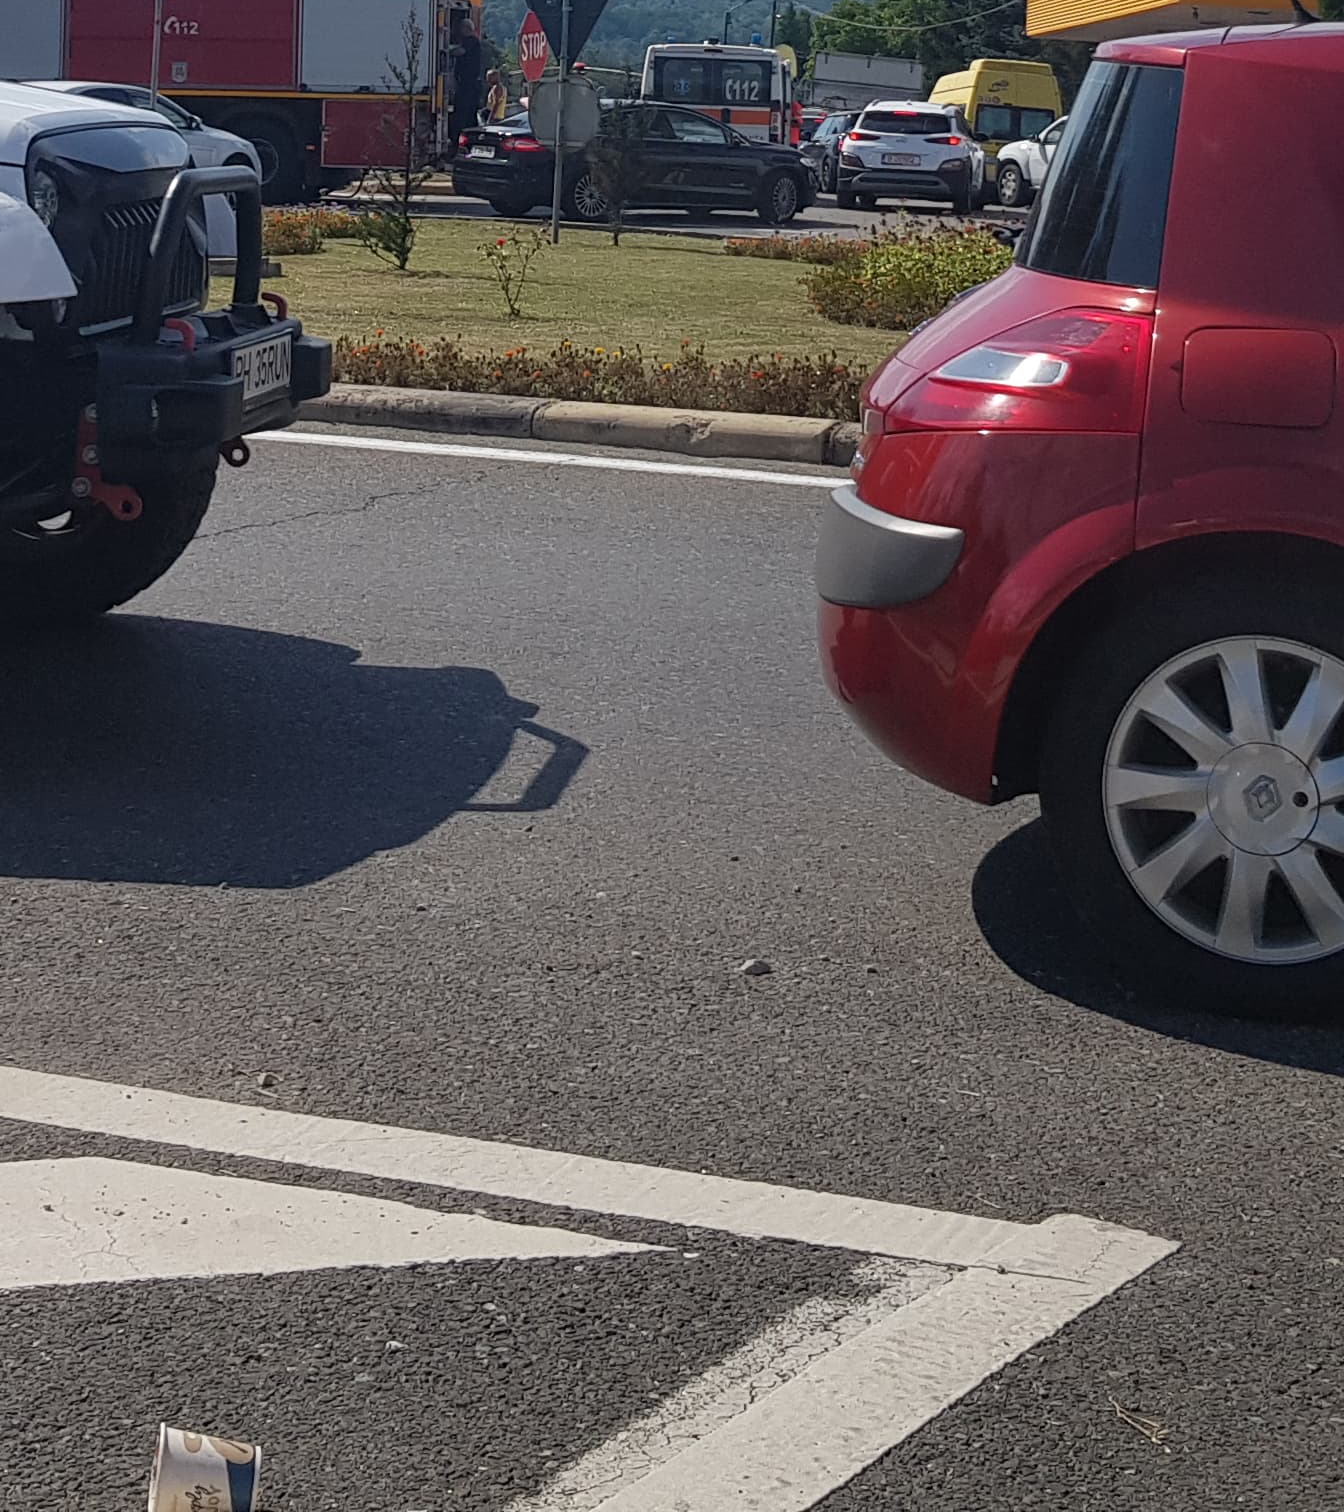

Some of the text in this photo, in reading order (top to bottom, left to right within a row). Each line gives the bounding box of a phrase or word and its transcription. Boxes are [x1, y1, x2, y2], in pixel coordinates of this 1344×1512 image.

[173, 21, 200, 35] 112
[521, 31, 547, 62] STOP
[733, 79, 759, 101] 112
[236, 351, 252, 391] PH
